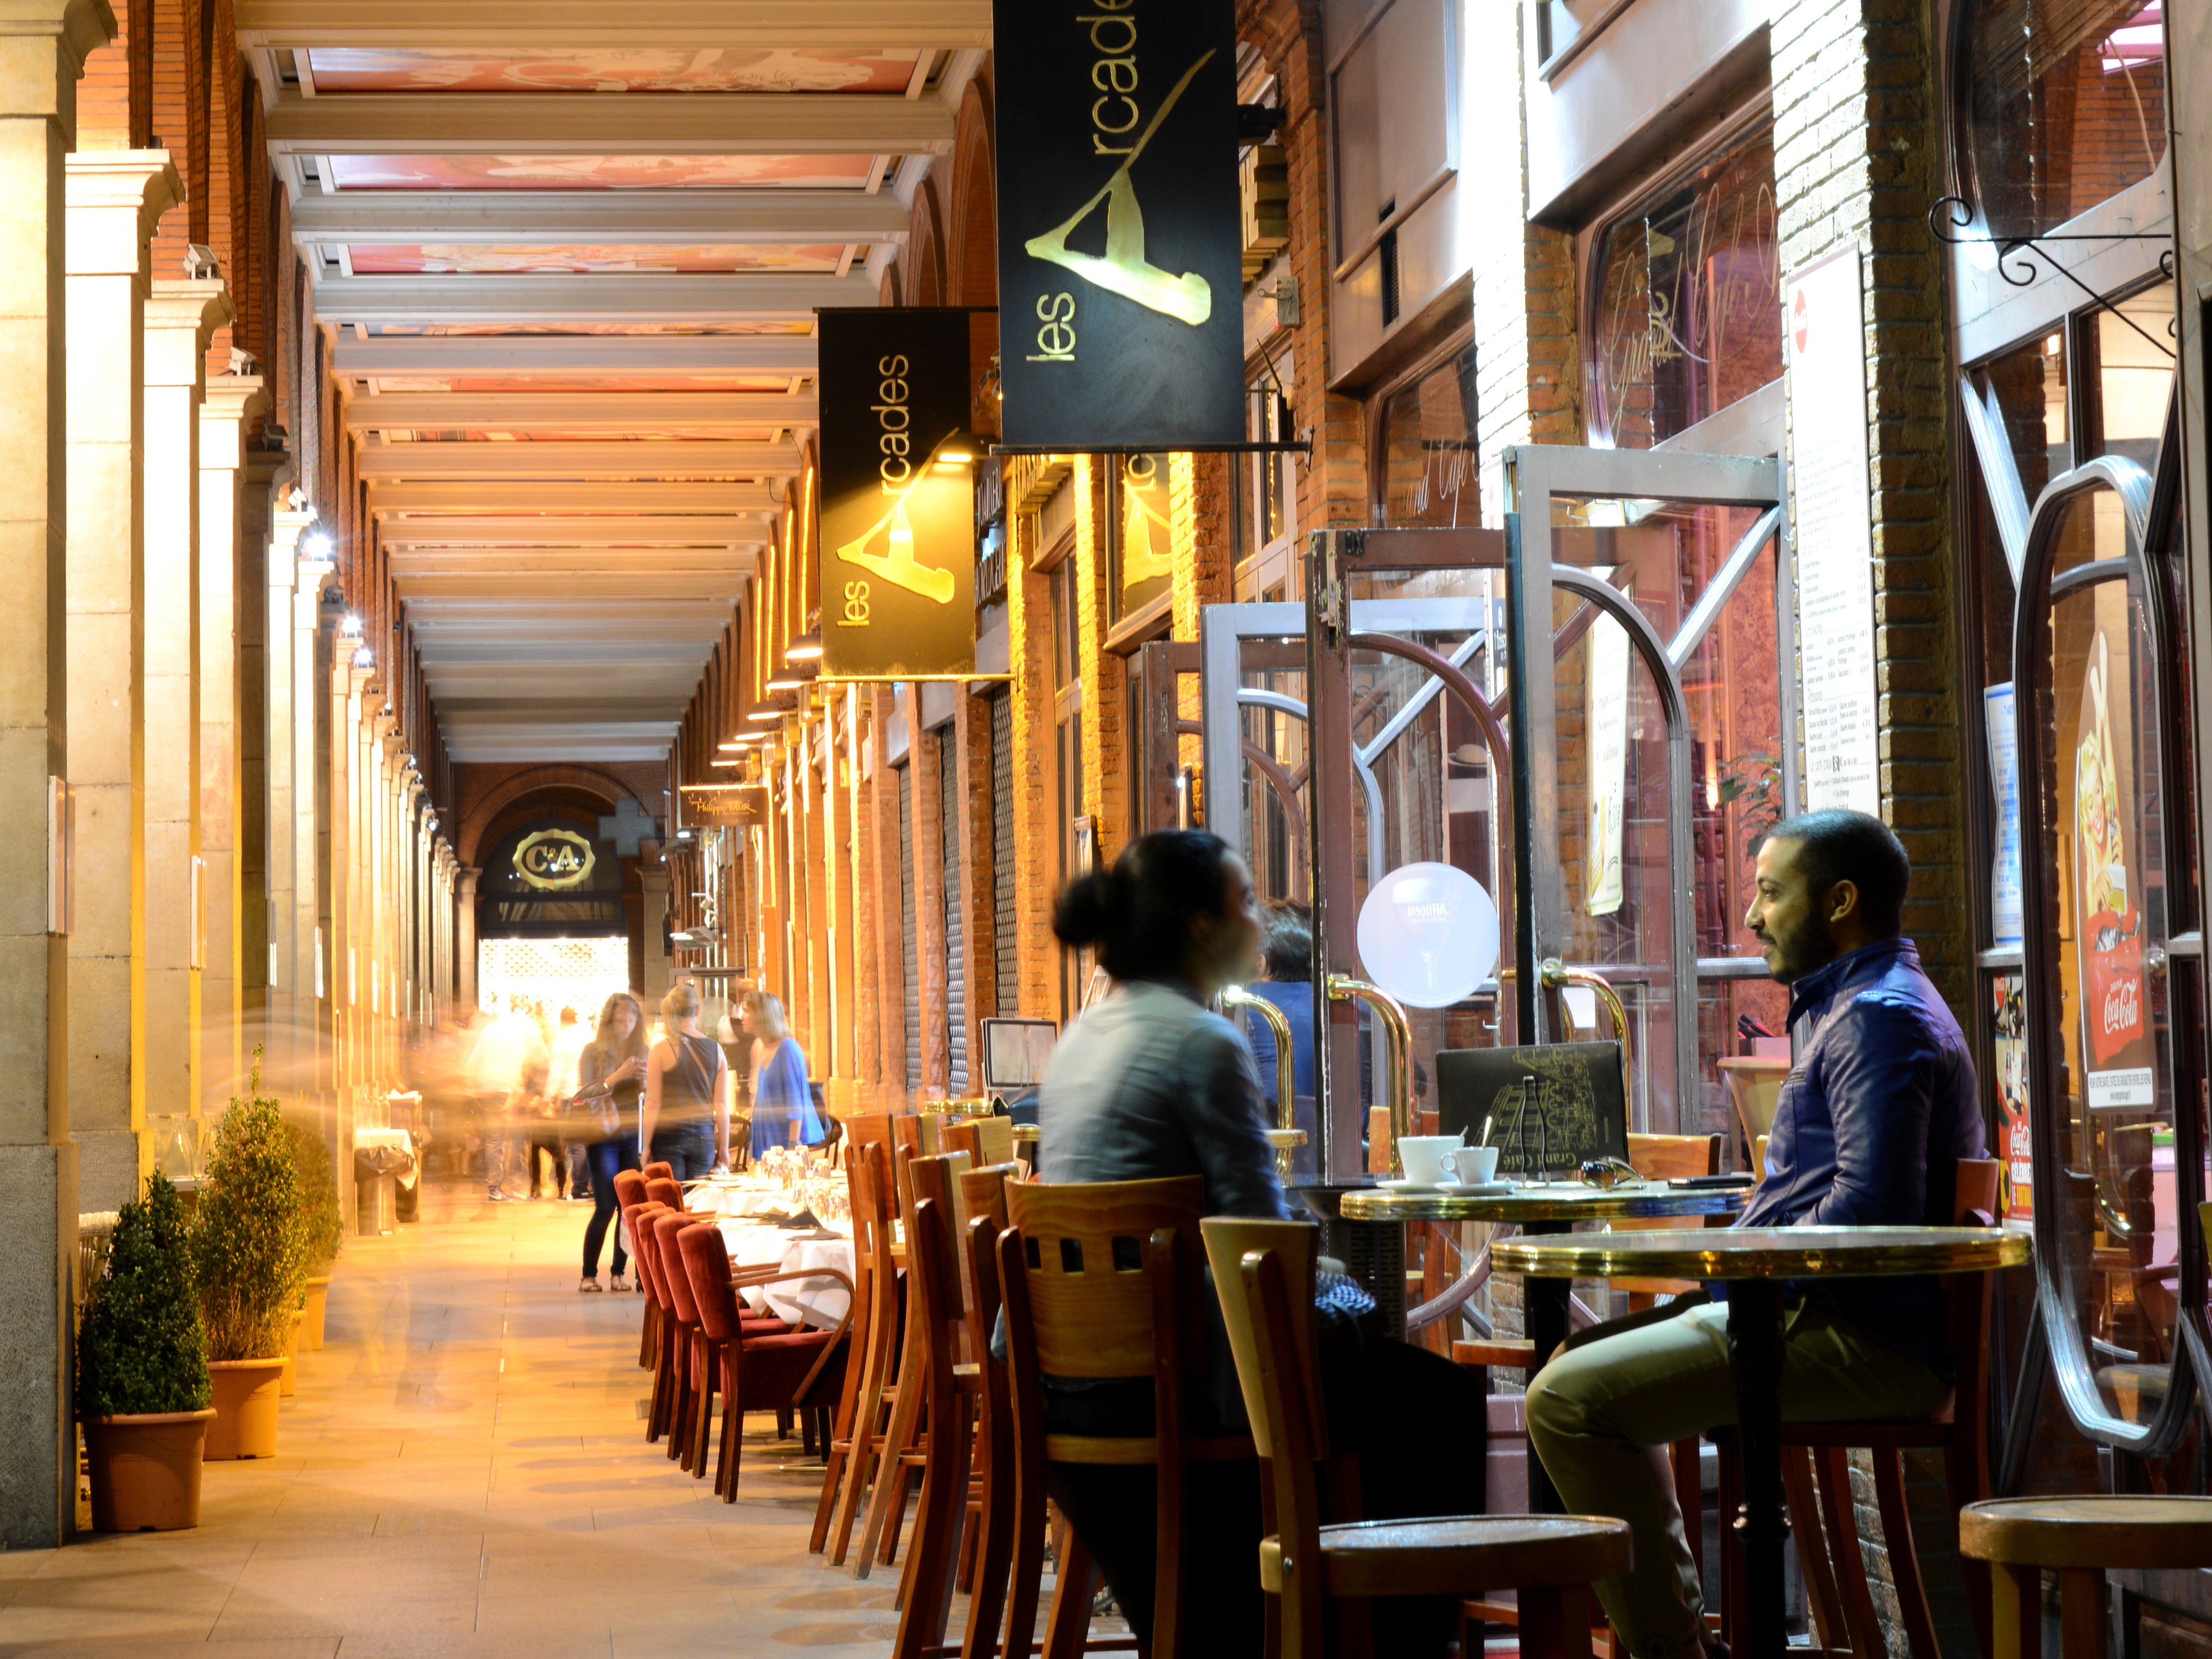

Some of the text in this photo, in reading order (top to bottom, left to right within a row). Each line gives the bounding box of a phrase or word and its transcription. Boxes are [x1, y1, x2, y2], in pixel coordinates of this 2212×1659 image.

[1024, 0, 1216, 364] les Arcad
[837, 580, 870, 627] les
[526, 845, 580, 873] C&A
[2110, 978, 2123, 993] DRINK
[1503, 1153, 1577, 1170] Grand Café
